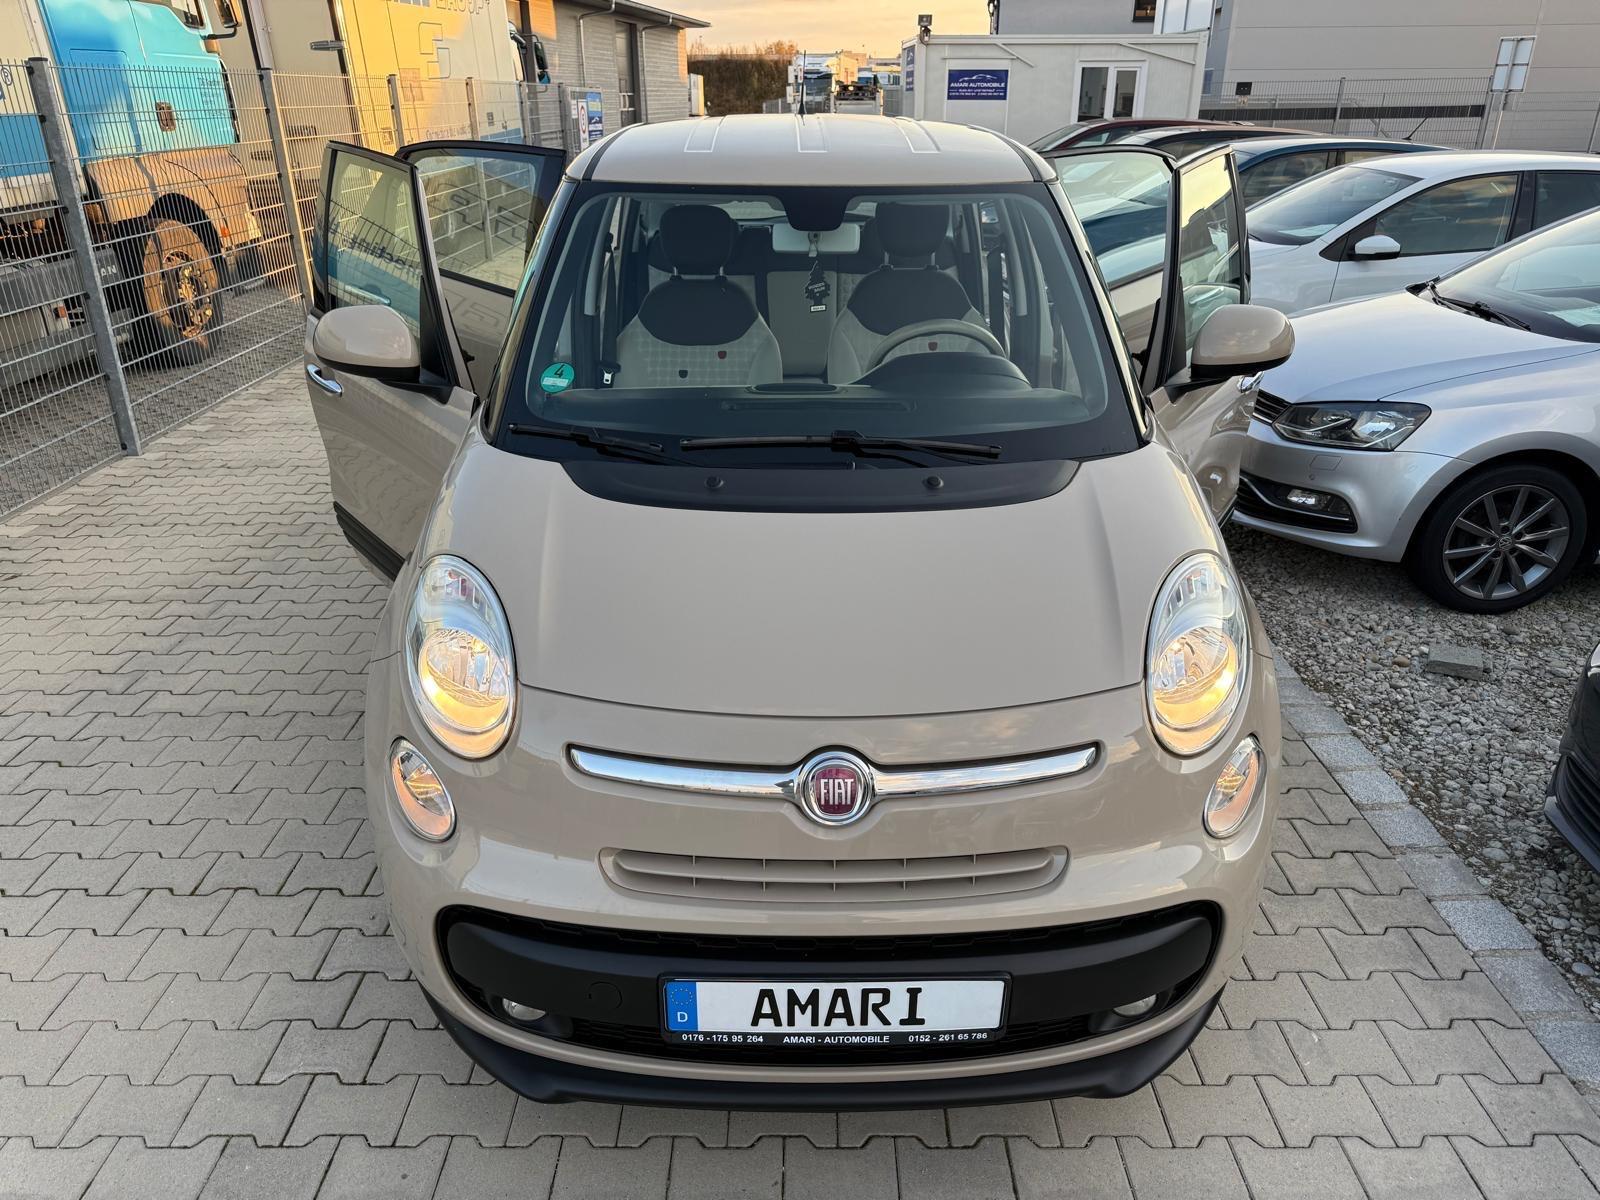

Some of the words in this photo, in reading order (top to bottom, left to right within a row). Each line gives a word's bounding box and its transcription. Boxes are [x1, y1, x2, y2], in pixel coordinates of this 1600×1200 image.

[554, 363, 566, 379] 4
[820, 778, 854, 806] FIAT
[750, 987, 926, 1027] AMARI
[677, 1011, 688, 1023] D
[681, 1033, 704, 1042] 0176
[712, 1034, 729, 1042] 175
[731, 1034, 743, 1042] 95
[746, 1035, 764, 1043] 264
[783, 1035, 816, 1044] AMARI
[823, 1035, 890, 1044] AUTOMOBILE
[908, 1034, 931, 1042] 0152
[938, 1034, 955, 1042] 261
[971, 1032, 988, 1040] 786
